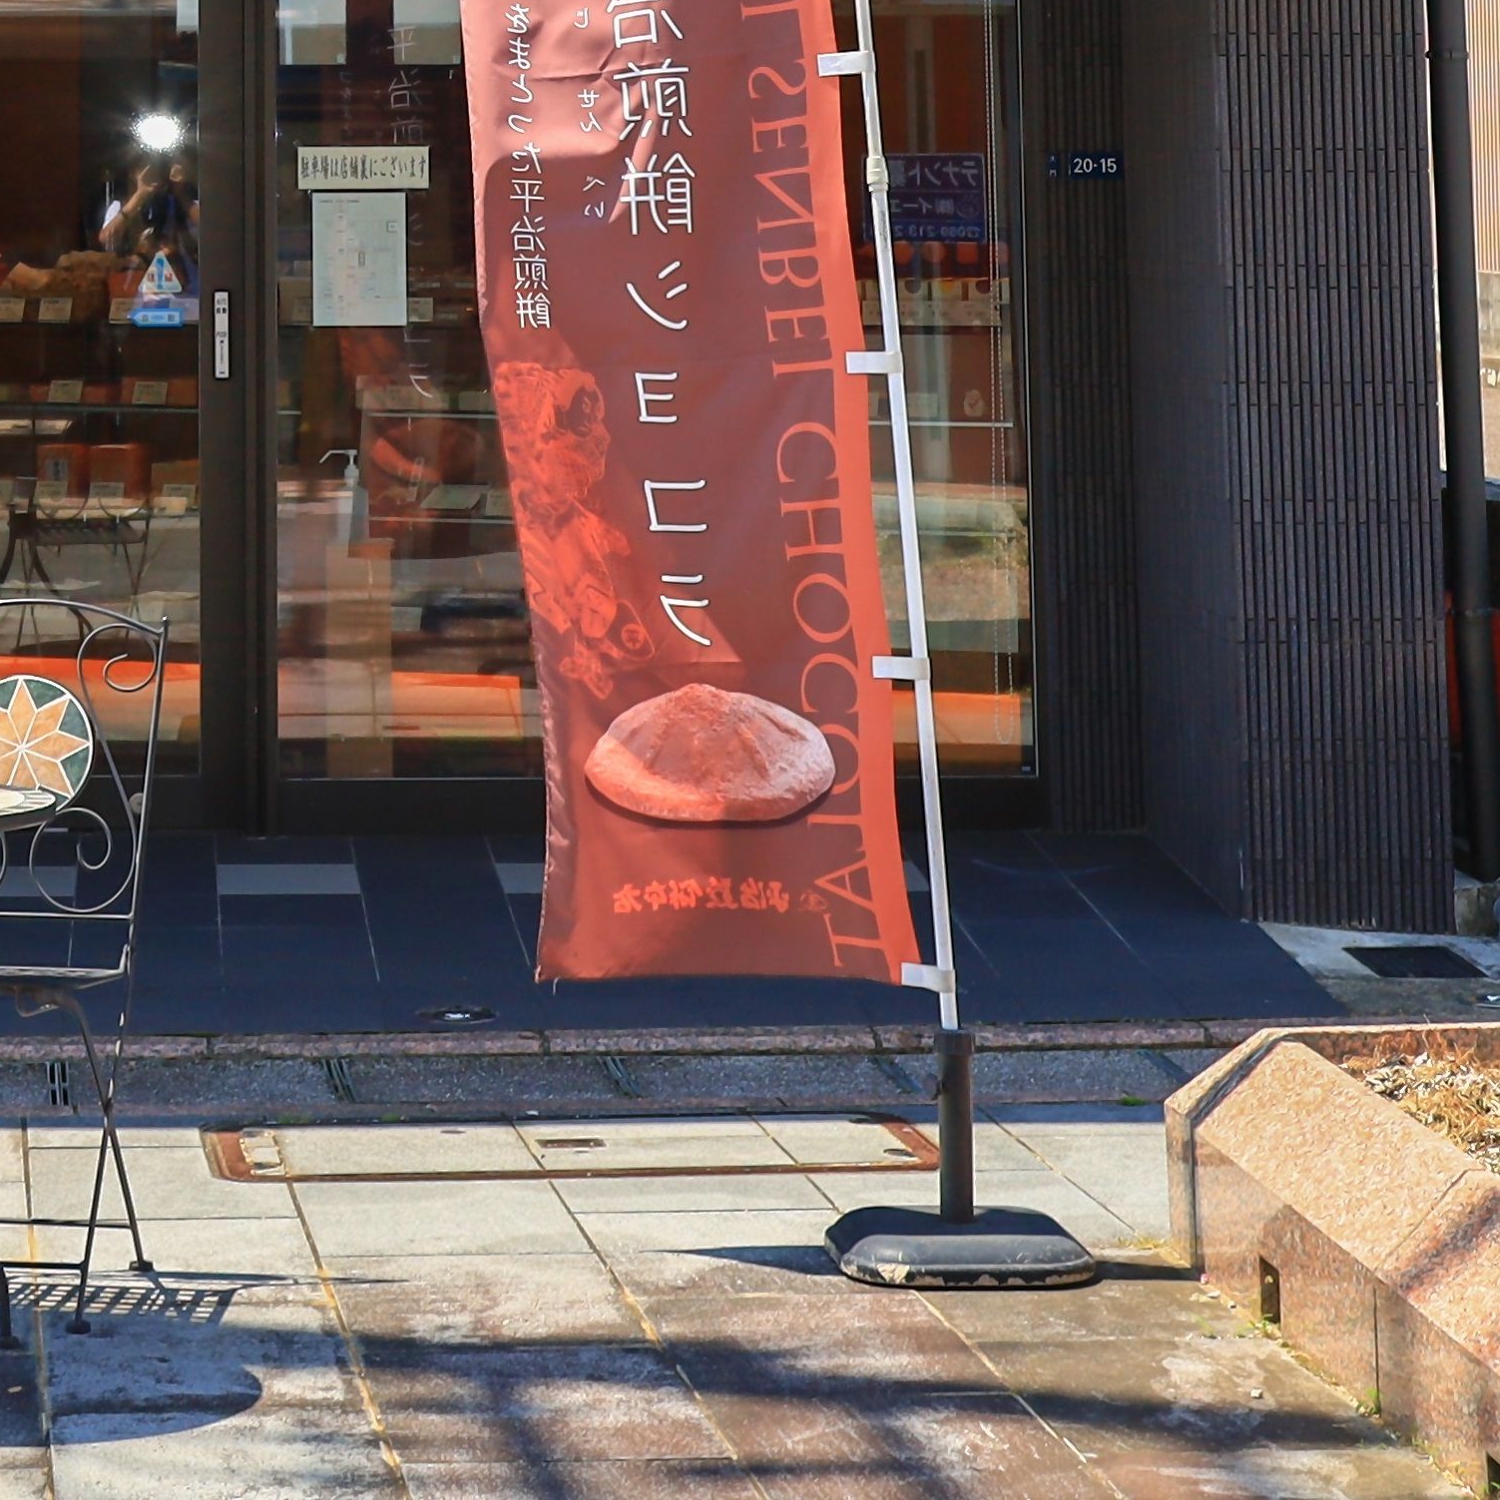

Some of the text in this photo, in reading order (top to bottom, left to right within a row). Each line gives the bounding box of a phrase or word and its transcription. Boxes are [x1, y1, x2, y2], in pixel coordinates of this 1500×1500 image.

[300, 153, 427, 181] 駐車場は店舗裏にございます
